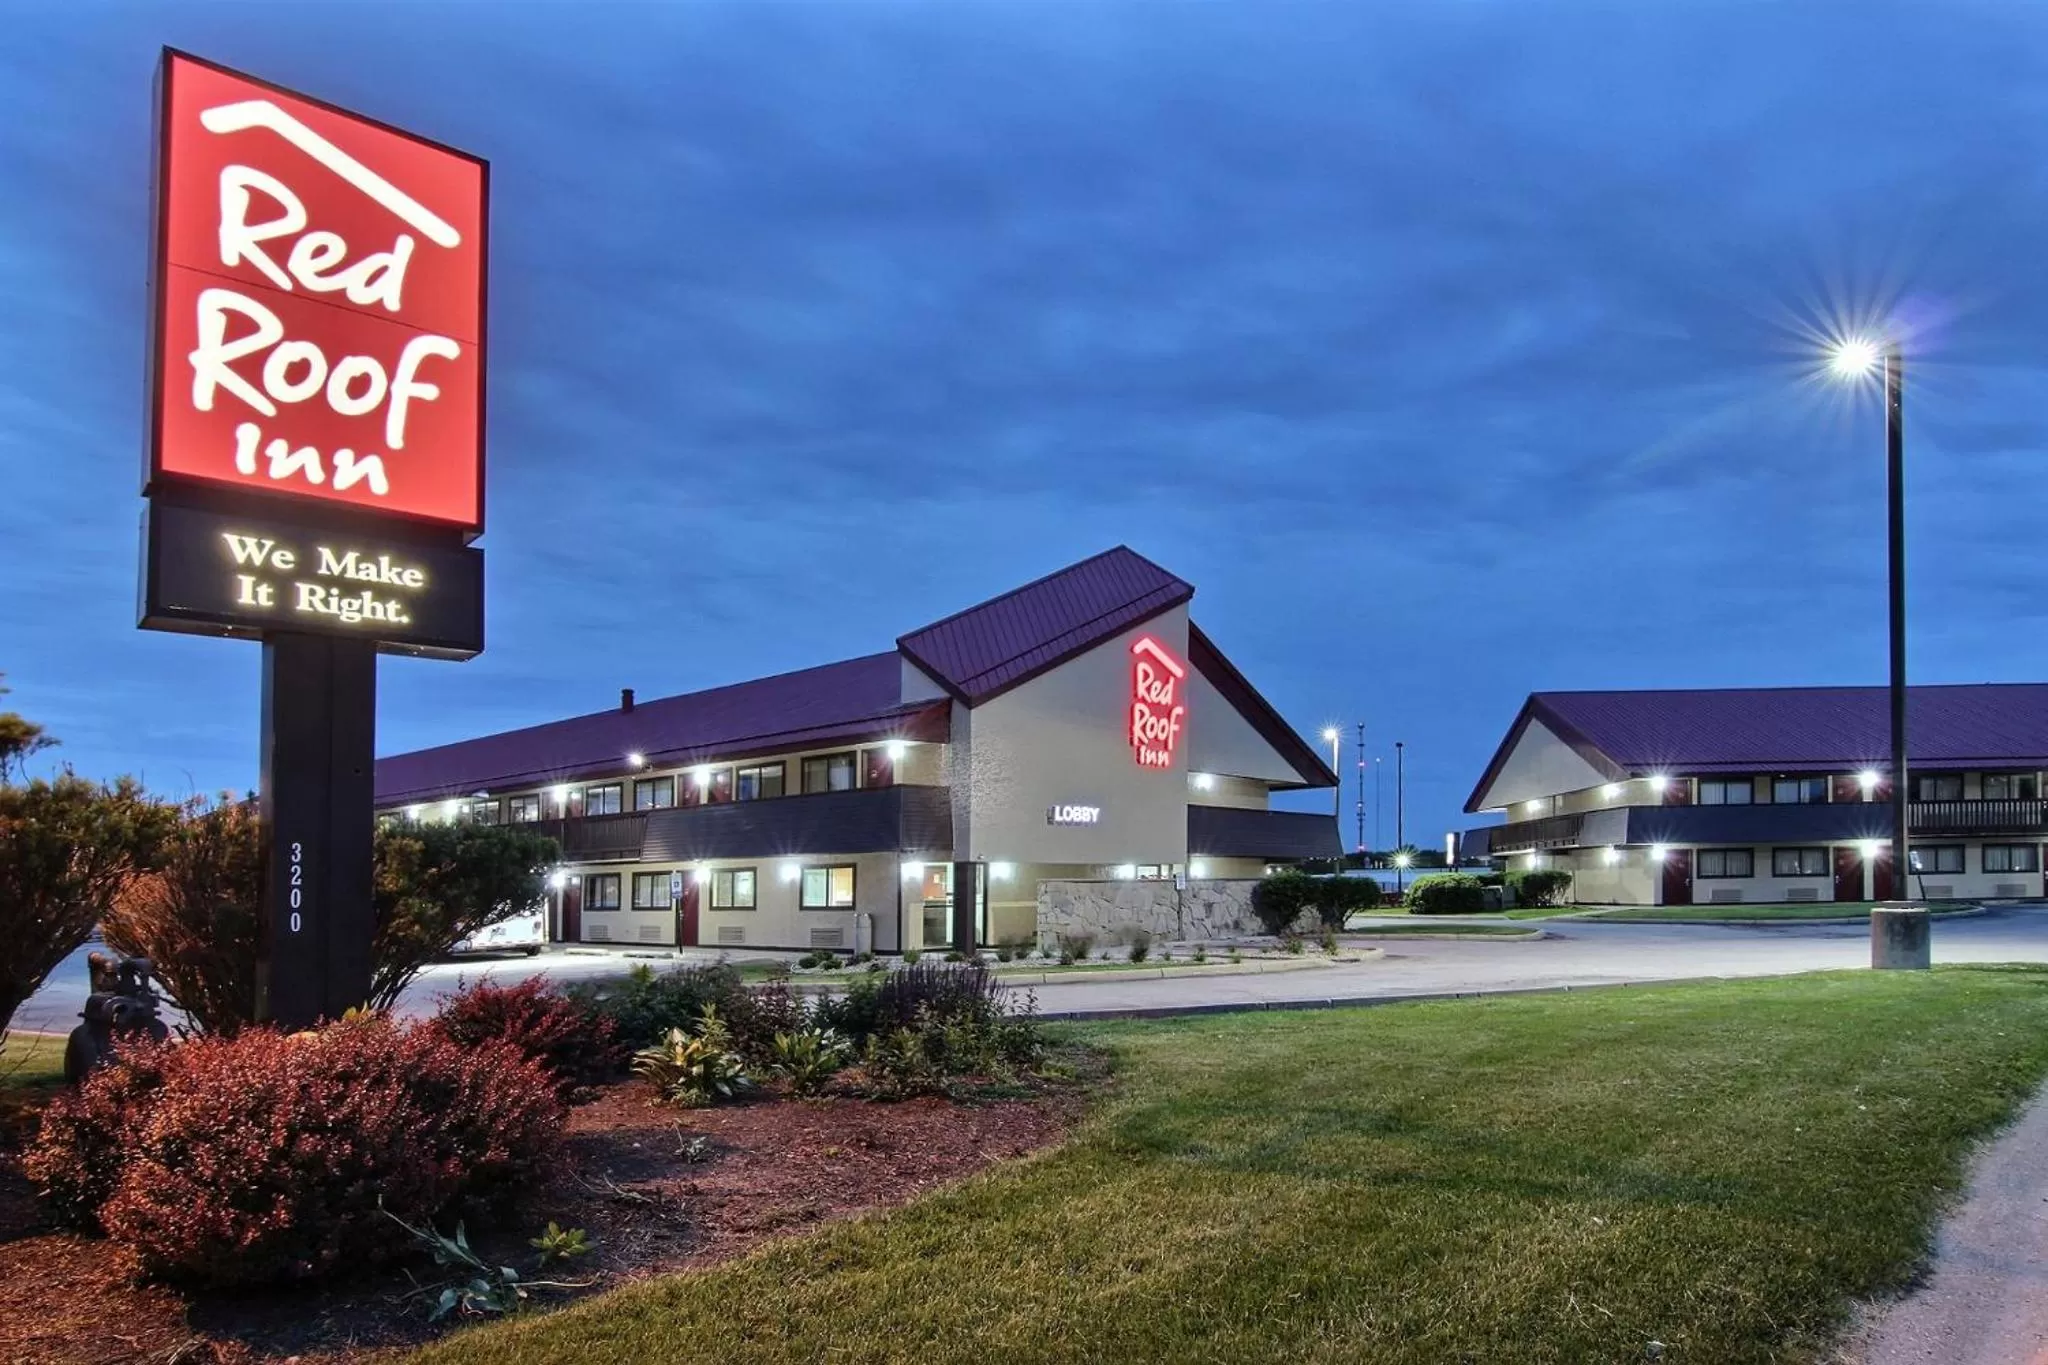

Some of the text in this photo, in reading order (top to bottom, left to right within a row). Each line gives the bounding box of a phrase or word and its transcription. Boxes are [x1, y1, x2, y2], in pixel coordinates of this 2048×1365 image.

[219, 164, 414, 312] Red
[188, 287, 460, 450] Roof
[235, 422, 389, 495] Inn
[222, 533, 424, 588] We Make
[237, 574, 410, 624] It Right.
[1136, 661, 1175, 705] Red
[1132, 702, 1184, 750] Roof
[1138, 745, 1170, 767] Inn
[1053, 805, 1100, 823] LOBBY
[290, 842, 302, 932] 3200
